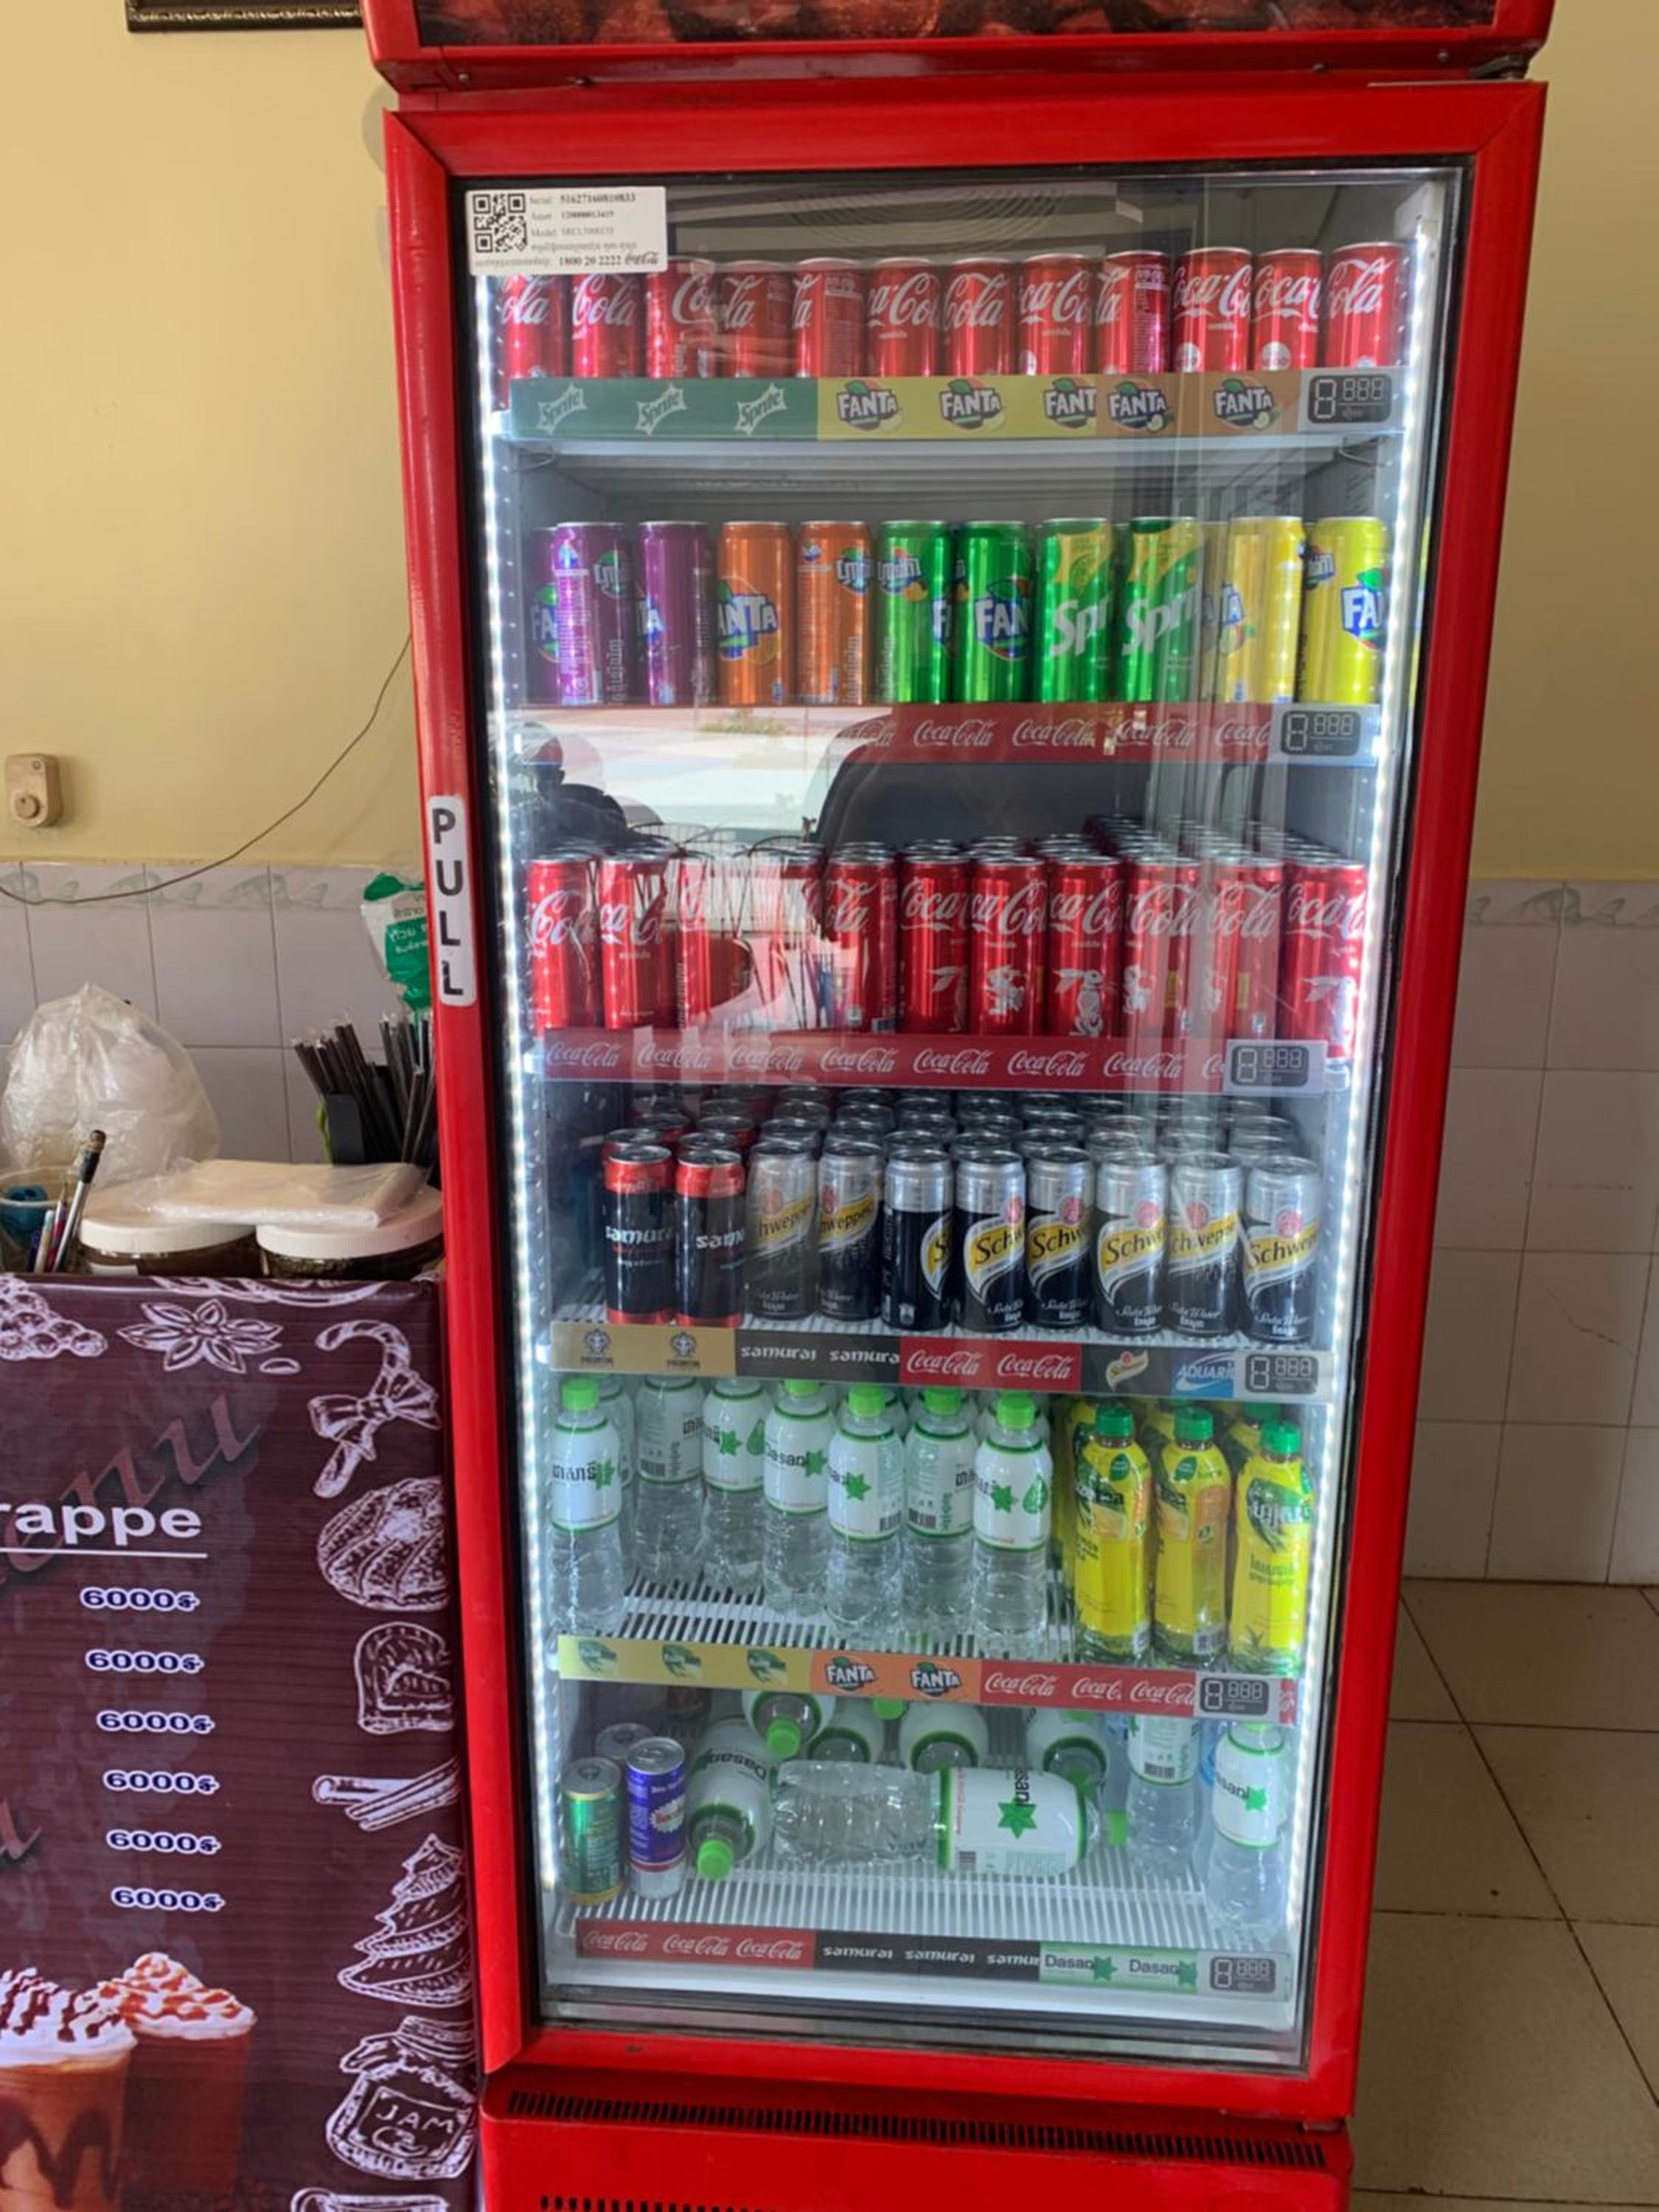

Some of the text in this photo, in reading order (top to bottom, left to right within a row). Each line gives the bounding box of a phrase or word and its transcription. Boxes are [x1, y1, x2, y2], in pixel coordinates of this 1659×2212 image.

[599, 255, 622, 265] 2222
[838, 392, 898, 419] FANTA
[942, 392, 1001, 419] FANTA
[1109, 392, 1166, 418] FANTA
[1215, 390, 1273, 415] FANTA
[431, 807, 464, 997] PULL
[827, 1663, 875, 1683] FANTA
[911, 1669, 961, 1688] FANTA
[375, 2104, 454, 2135] JAM
